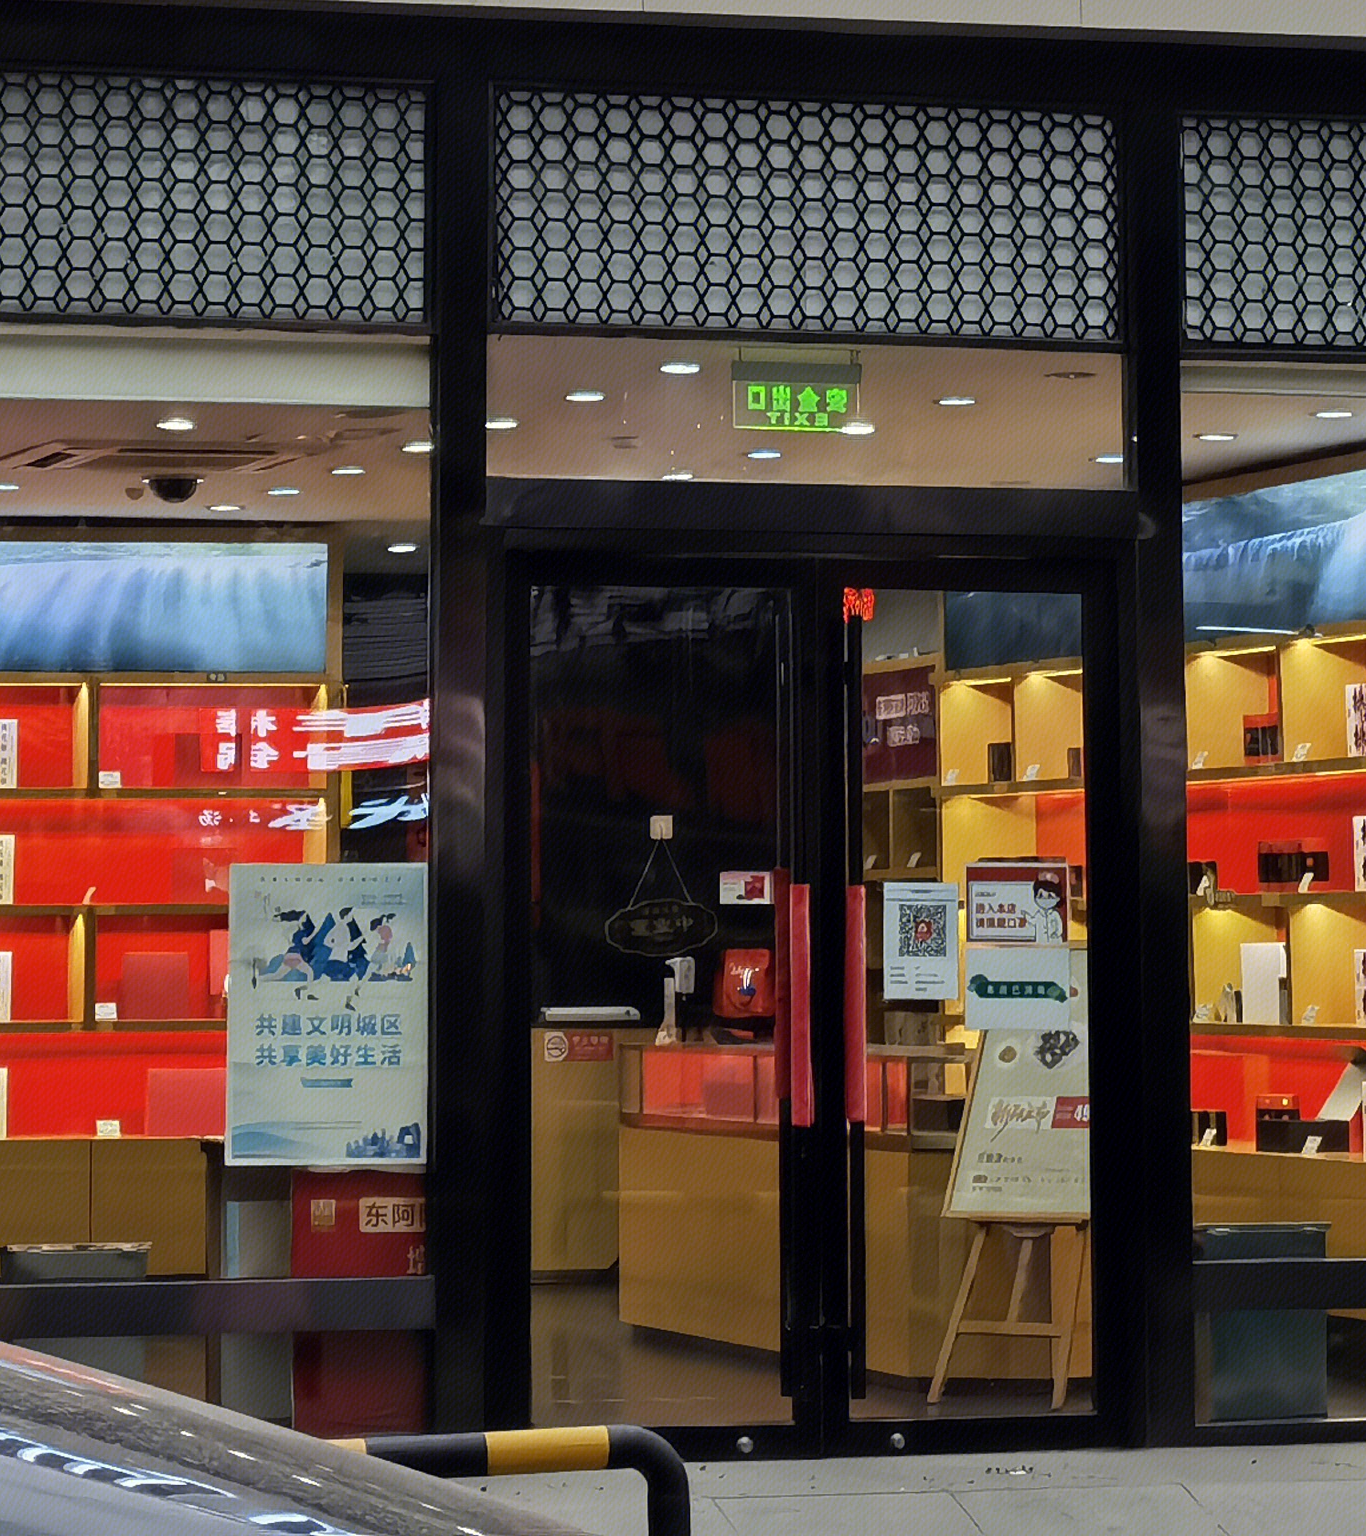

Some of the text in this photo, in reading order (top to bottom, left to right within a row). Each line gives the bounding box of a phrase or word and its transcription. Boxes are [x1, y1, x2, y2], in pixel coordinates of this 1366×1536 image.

[255, 1013, 403, 1036] 共建文明城区
[255, 1043, 403, 1066] 共享美好生活
[364, 1201, 424, 1228] 东阿
